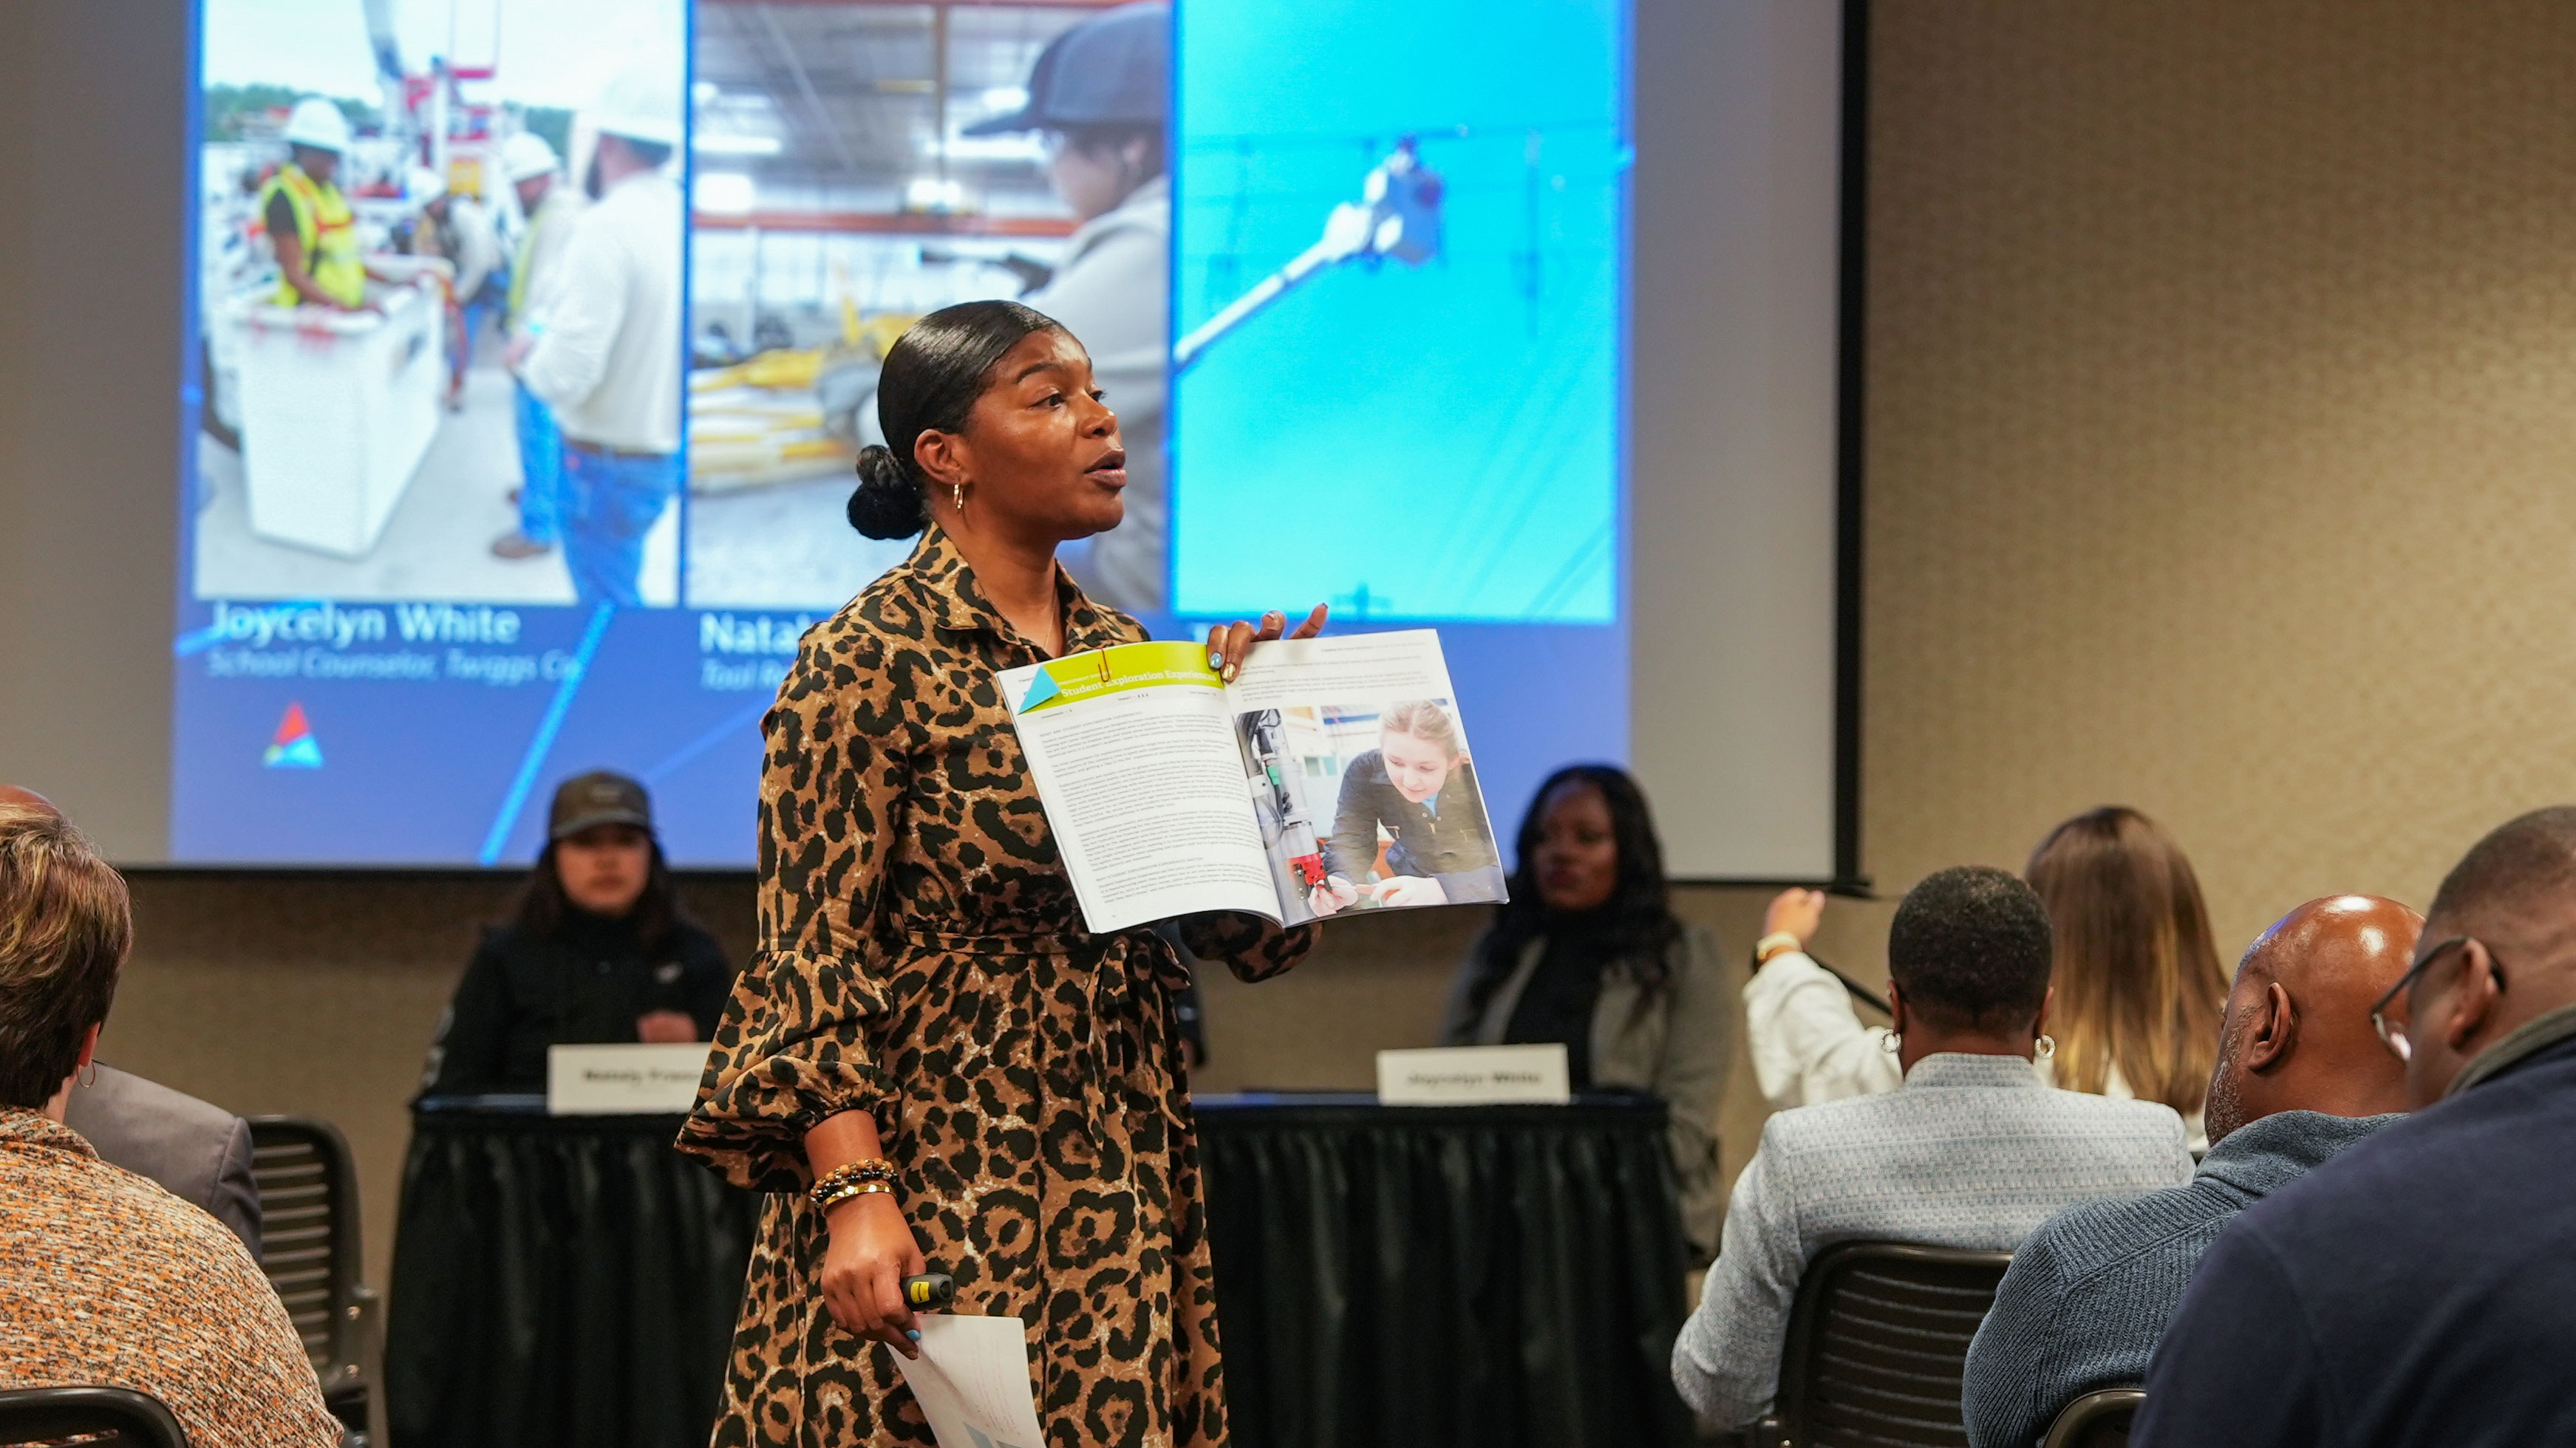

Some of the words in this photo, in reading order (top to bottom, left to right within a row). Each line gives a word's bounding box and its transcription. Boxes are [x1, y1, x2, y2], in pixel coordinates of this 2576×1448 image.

[214, 601, 385, 647] Joycelyn
[395, 603, 519, 643] White
[206, 645, 299, 677] School
[1061, 682, 1104, 697] Student
[1105, 671, 1165, 687] Exploration
[1165, 669, 1217, 681] Experiences
